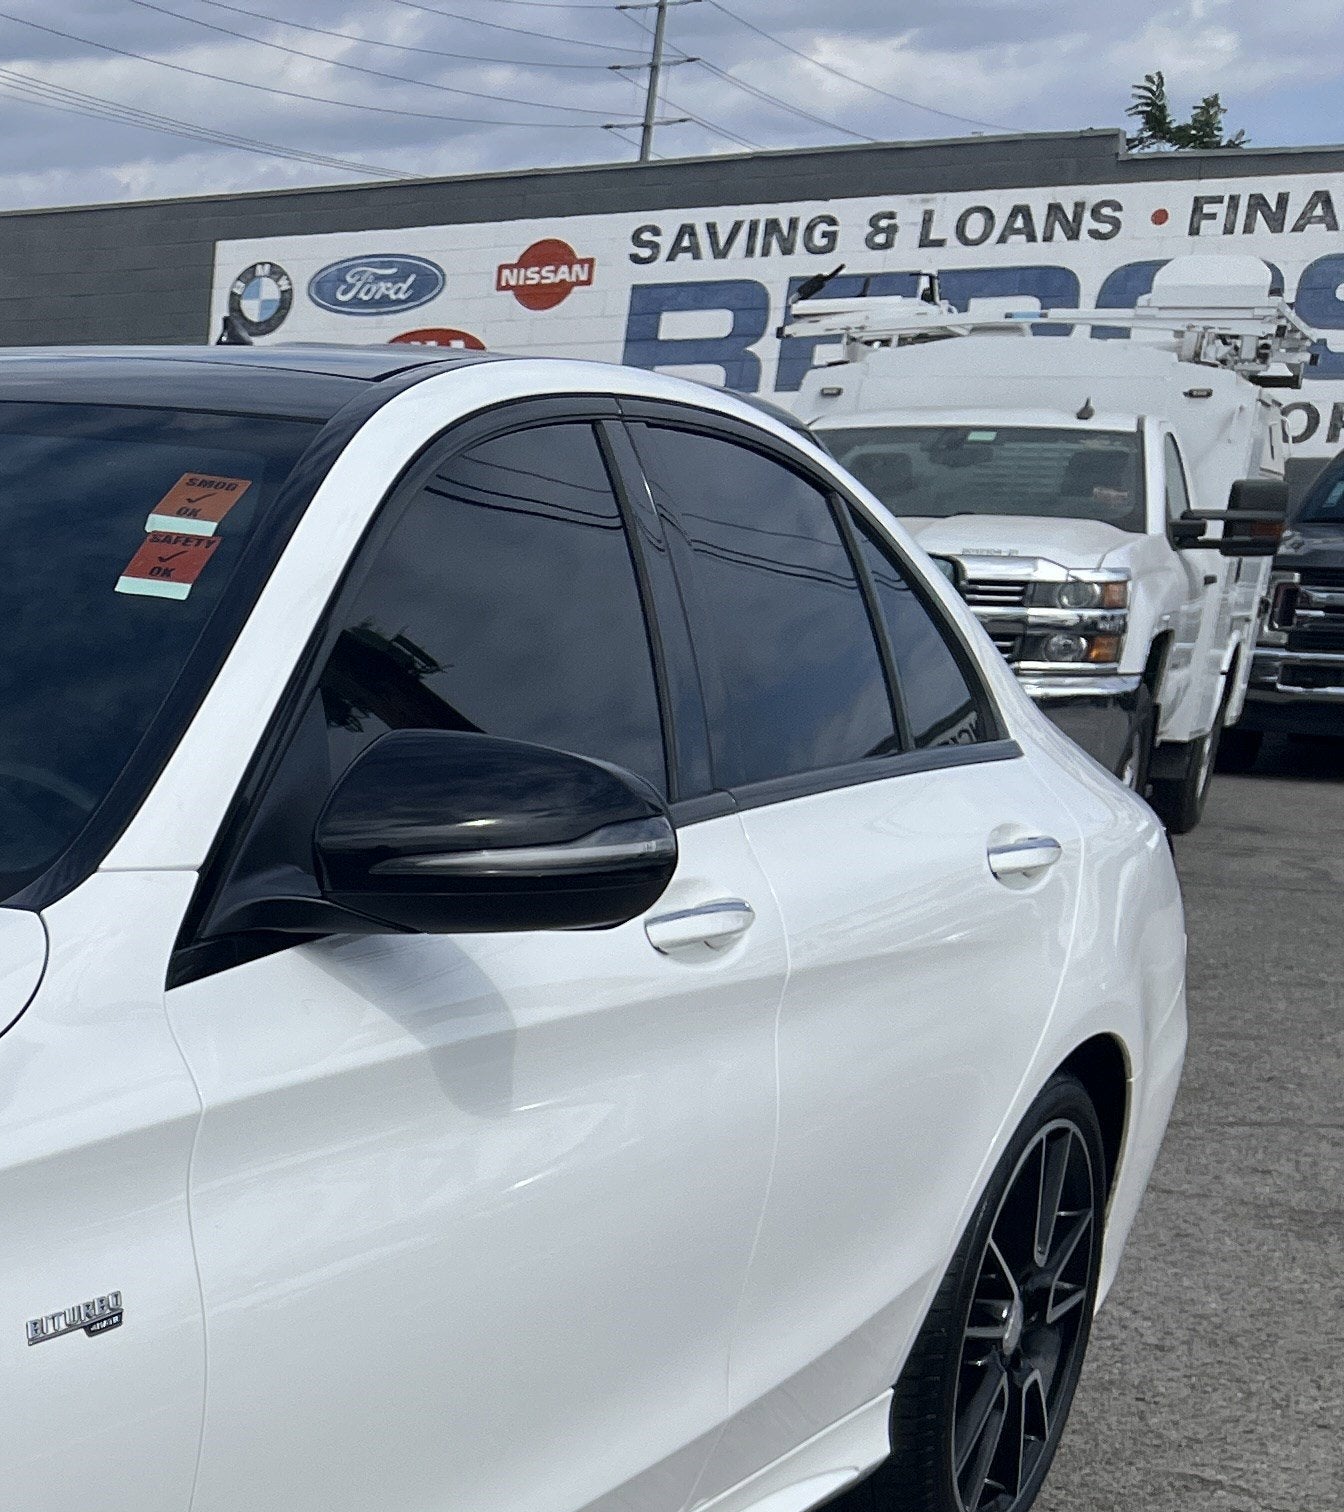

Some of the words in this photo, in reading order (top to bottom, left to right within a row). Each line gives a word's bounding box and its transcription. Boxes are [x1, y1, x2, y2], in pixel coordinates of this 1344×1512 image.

[628, 213, 841, 265] SAVING
[864, 209, 900, 251] &
[917, 198, 1125, 249] LOANS
[1187, 189, 1340, 237] FINA
[231, 262, 293, 296] BMW
[335, 266, 417, 303] Ford
[500, 262, 590, 287] NISSAN
[186, 477, 239, 492] SMOG
[176, 506, 202, 518] OK
[149, 533, 217, 548] SAFETY
[148, 566, 175, 577] OK
[25, 1289, 123, 1340] BITURBO
